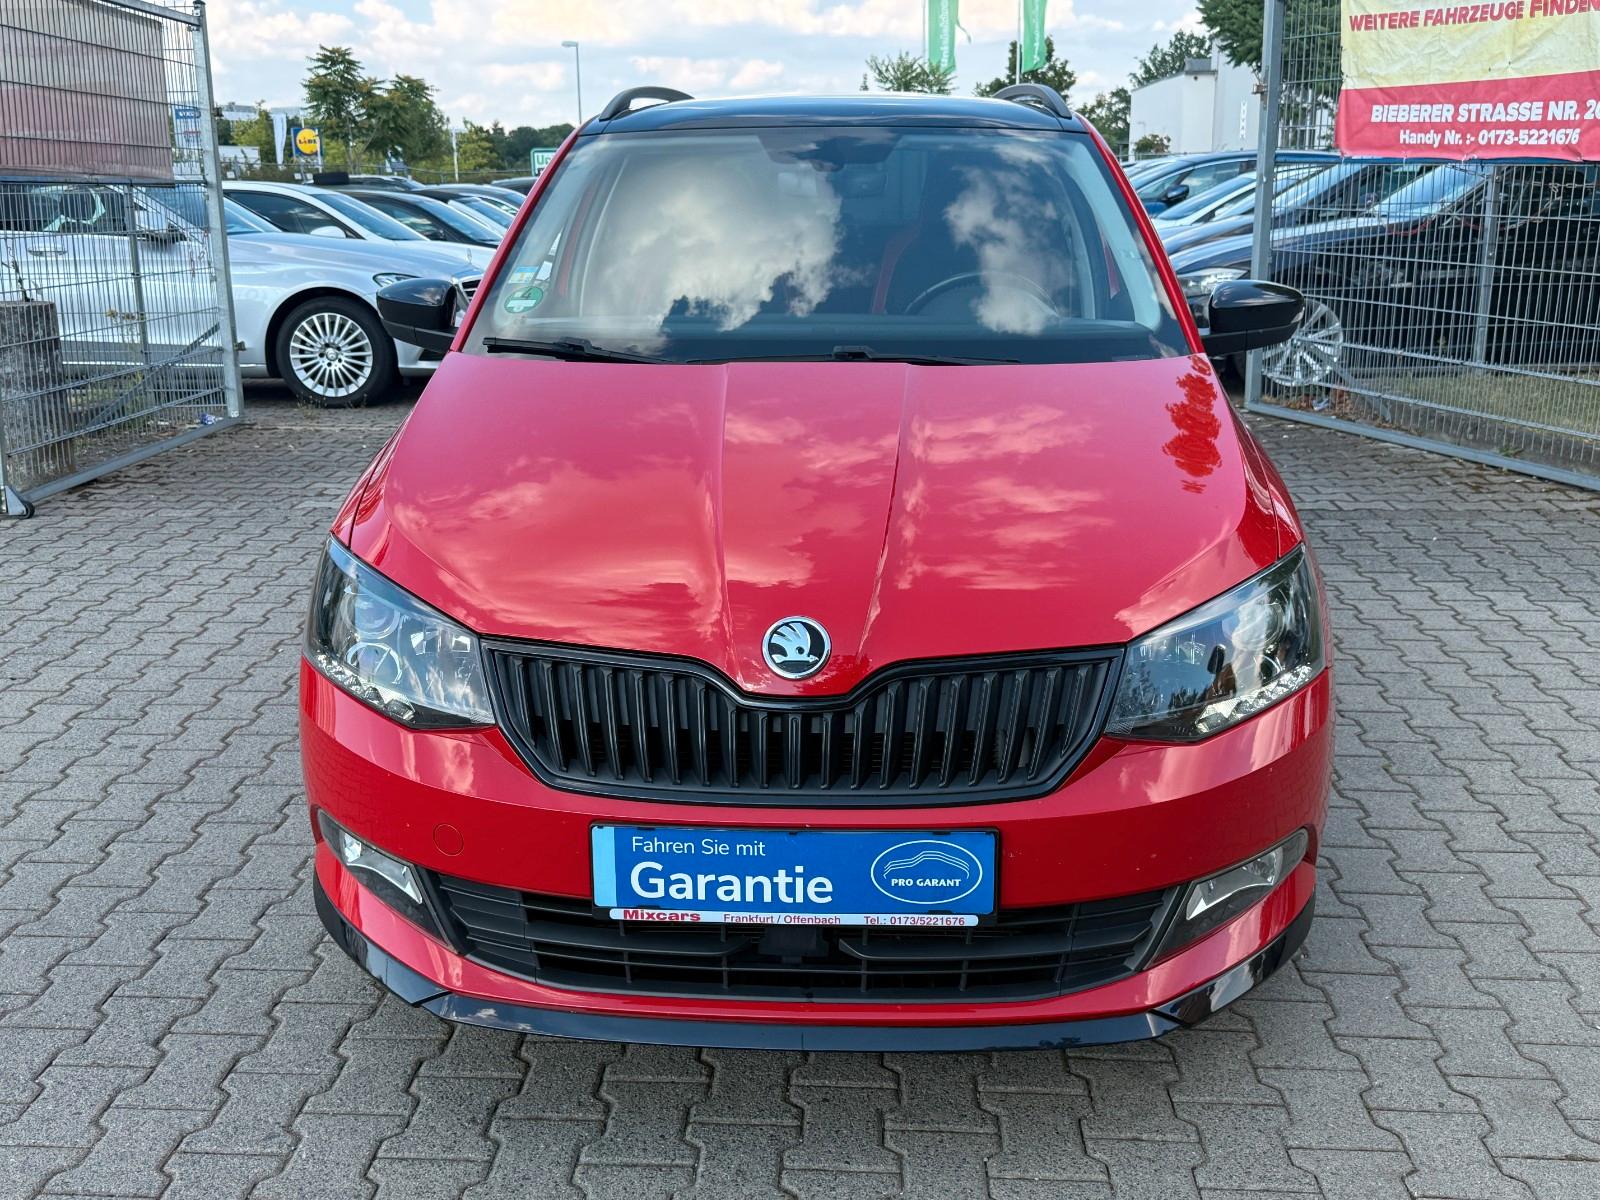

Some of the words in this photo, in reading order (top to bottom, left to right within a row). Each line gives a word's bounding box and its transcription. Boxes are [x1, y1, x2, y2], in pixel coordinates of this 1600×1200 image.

[1349, 11, 1420, 32] WEITERE
[1423, 1, 1524, 27] FAHRZEUGE
[1371, 104, 1454, 122] BIEBERER
[1457, 102, 1543, 122] STRASSE
[1400, 129, 1441, 148] Handy
[1444, 130, 1462, 145] Nr.
[1478, 128, 1580, 145] 0173-5221676
[632, 836, 695, 854] Fahren
[701, 839, 729, 855] Sie
[736, 841, 766, 856] mit
[630, 861, 833, 904] Garantie
[891, 879, 914, 887] PRO
[916, 879, 961, 887] GARANT
[623, 909, 701, 922] Mixcars
[723, 913, 774, 924] Frankfurt
[783, 914, 841, 925] Offenbach
[889, 915, 965, 926] 0173/5221676
